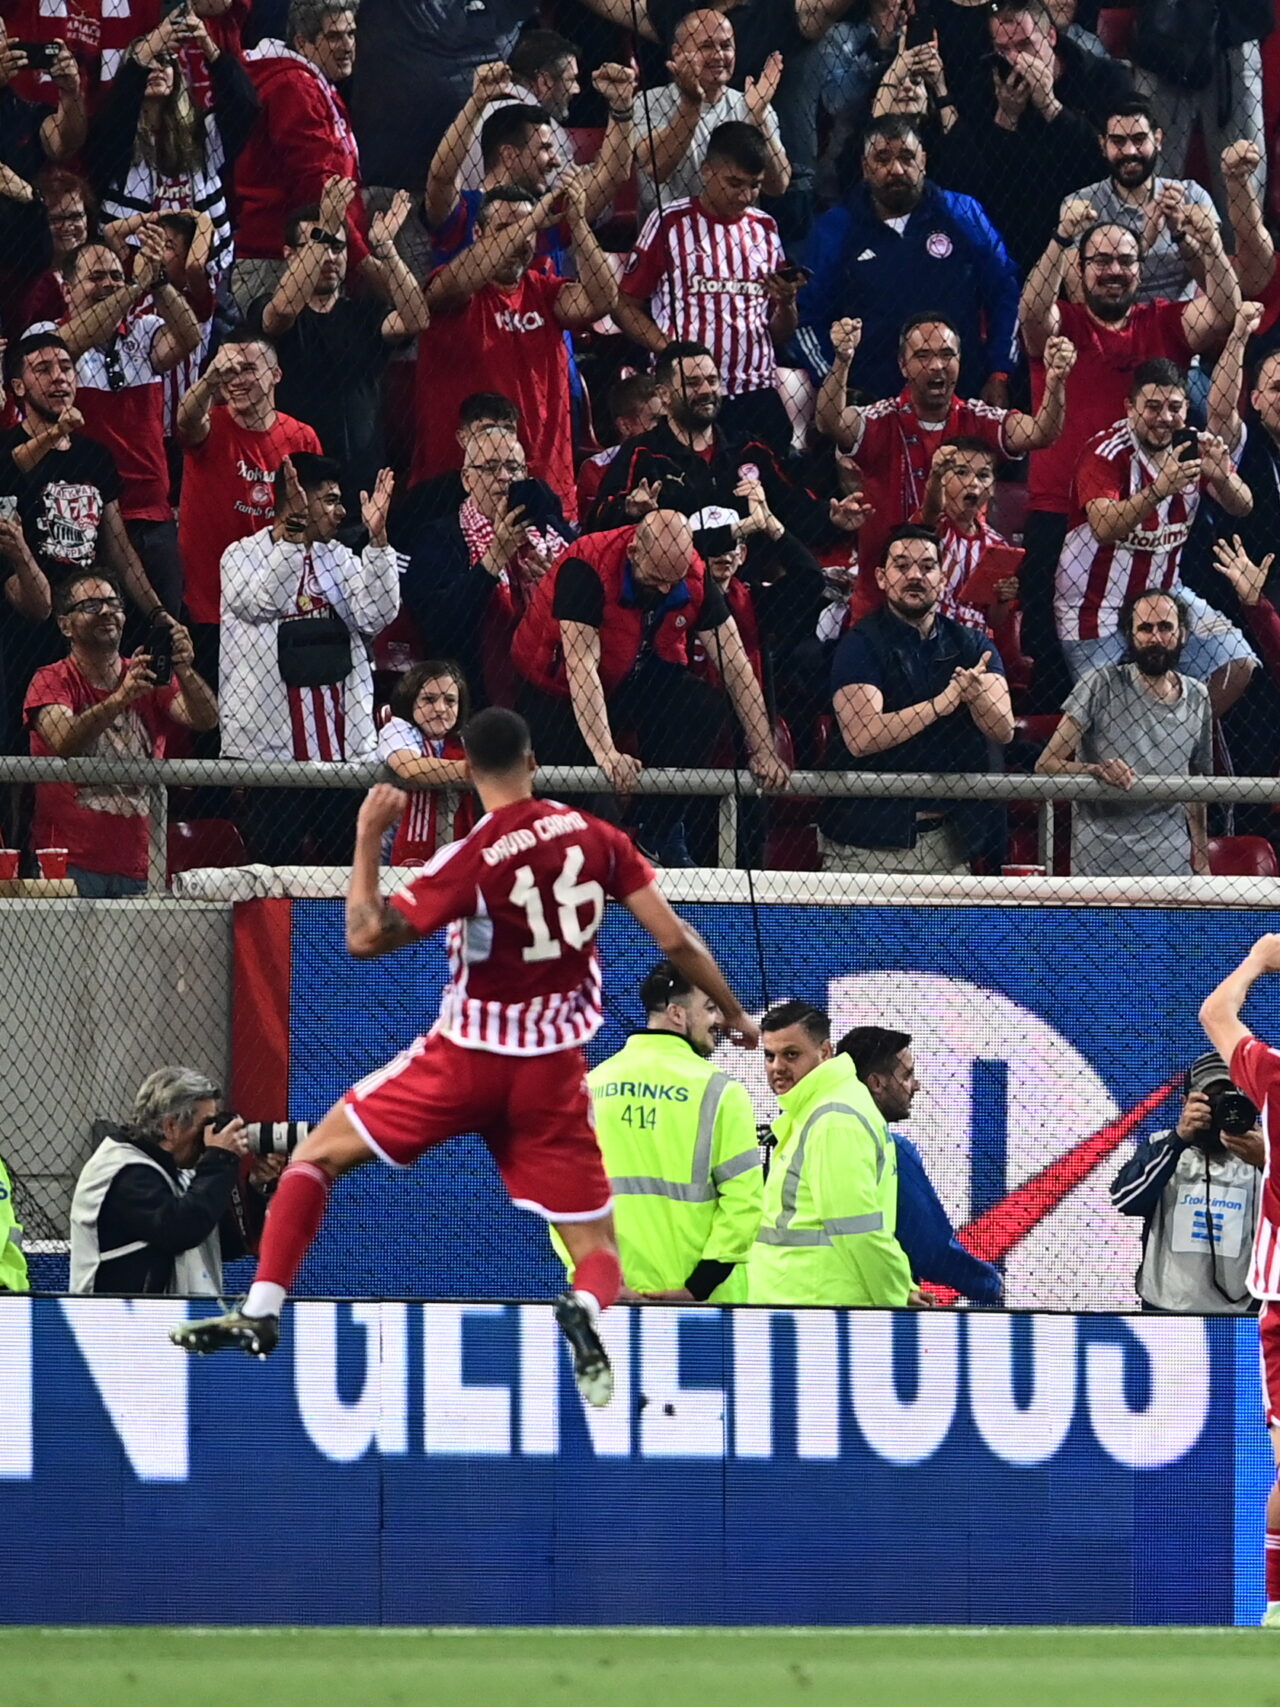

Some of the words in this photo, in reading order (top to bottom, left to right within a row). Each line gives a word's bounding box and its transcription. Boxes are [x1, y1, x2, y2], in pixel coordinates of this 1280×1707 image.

[509, 844, 604, 963] 16
[605, 1081, 690, 1102] BRINKS
[620, 1104, 657, 1131] 414
